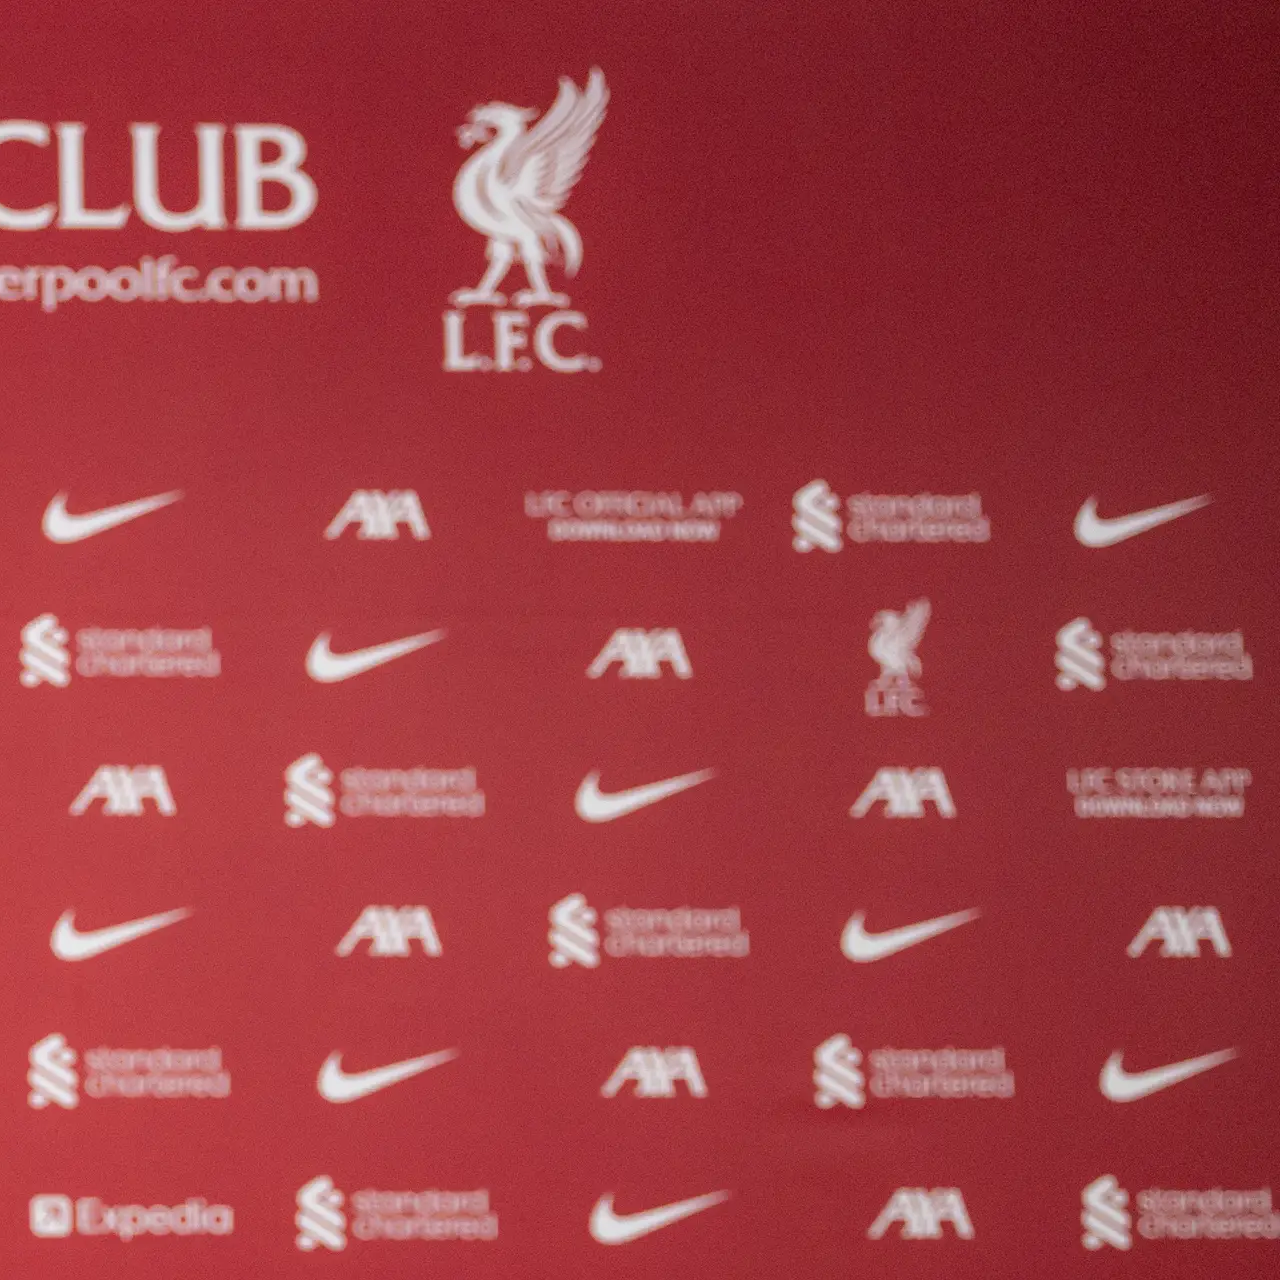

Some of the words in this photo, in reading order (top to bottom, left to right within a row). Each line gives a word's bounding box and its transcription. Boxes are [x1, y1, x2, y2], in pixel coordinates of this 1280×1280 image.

[327, 491, 429, 539] AXA
[589, 629, 691, 678] AXA
[72, 766, 175, 815] AXA
[853, 768, 955, 817] AXA
[338, 906, 441, 956] AXA
[1129, 907, 1230, 957] AXA
[603, 1047, 706, 1097] AXA
[74, 1197, 234, 1239] Expedia
[870, 1189, 973, 1239] AXA
